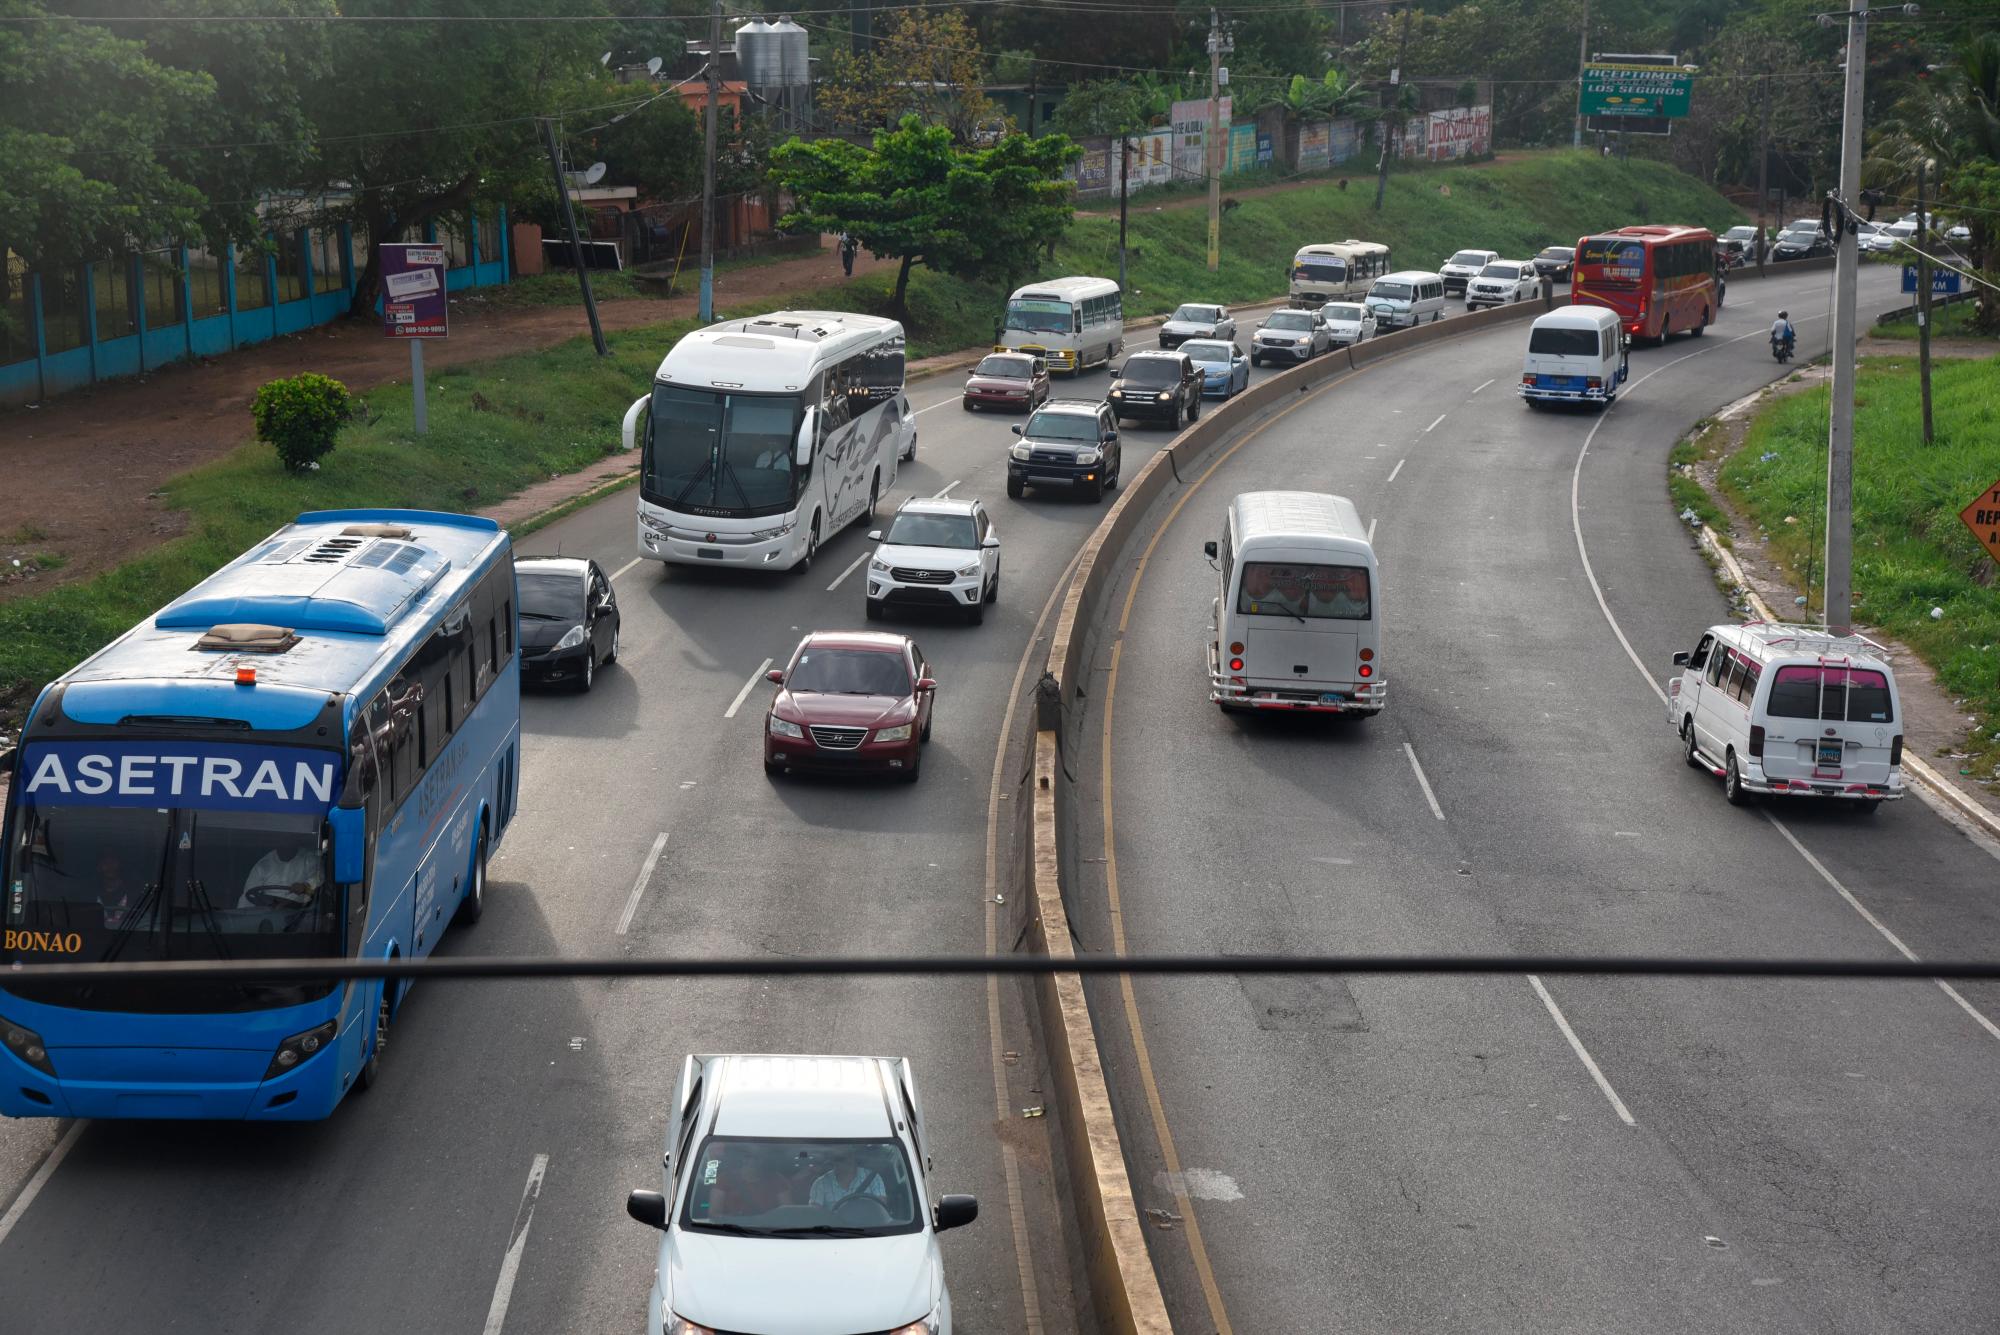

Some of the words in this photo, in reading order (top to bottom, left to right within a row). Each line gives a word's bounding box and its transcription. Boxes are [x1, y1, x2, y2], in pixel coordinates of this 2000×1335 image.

[1588, 69, 1688, 80] ACEPTAMOS
[1588, 85, 1615, 93] LOS
[1619, 86, 1685, 96] SEGUROS
[25, 753, 334, 803] ASETRAN
[4, 929, 82, 954] BONAO
